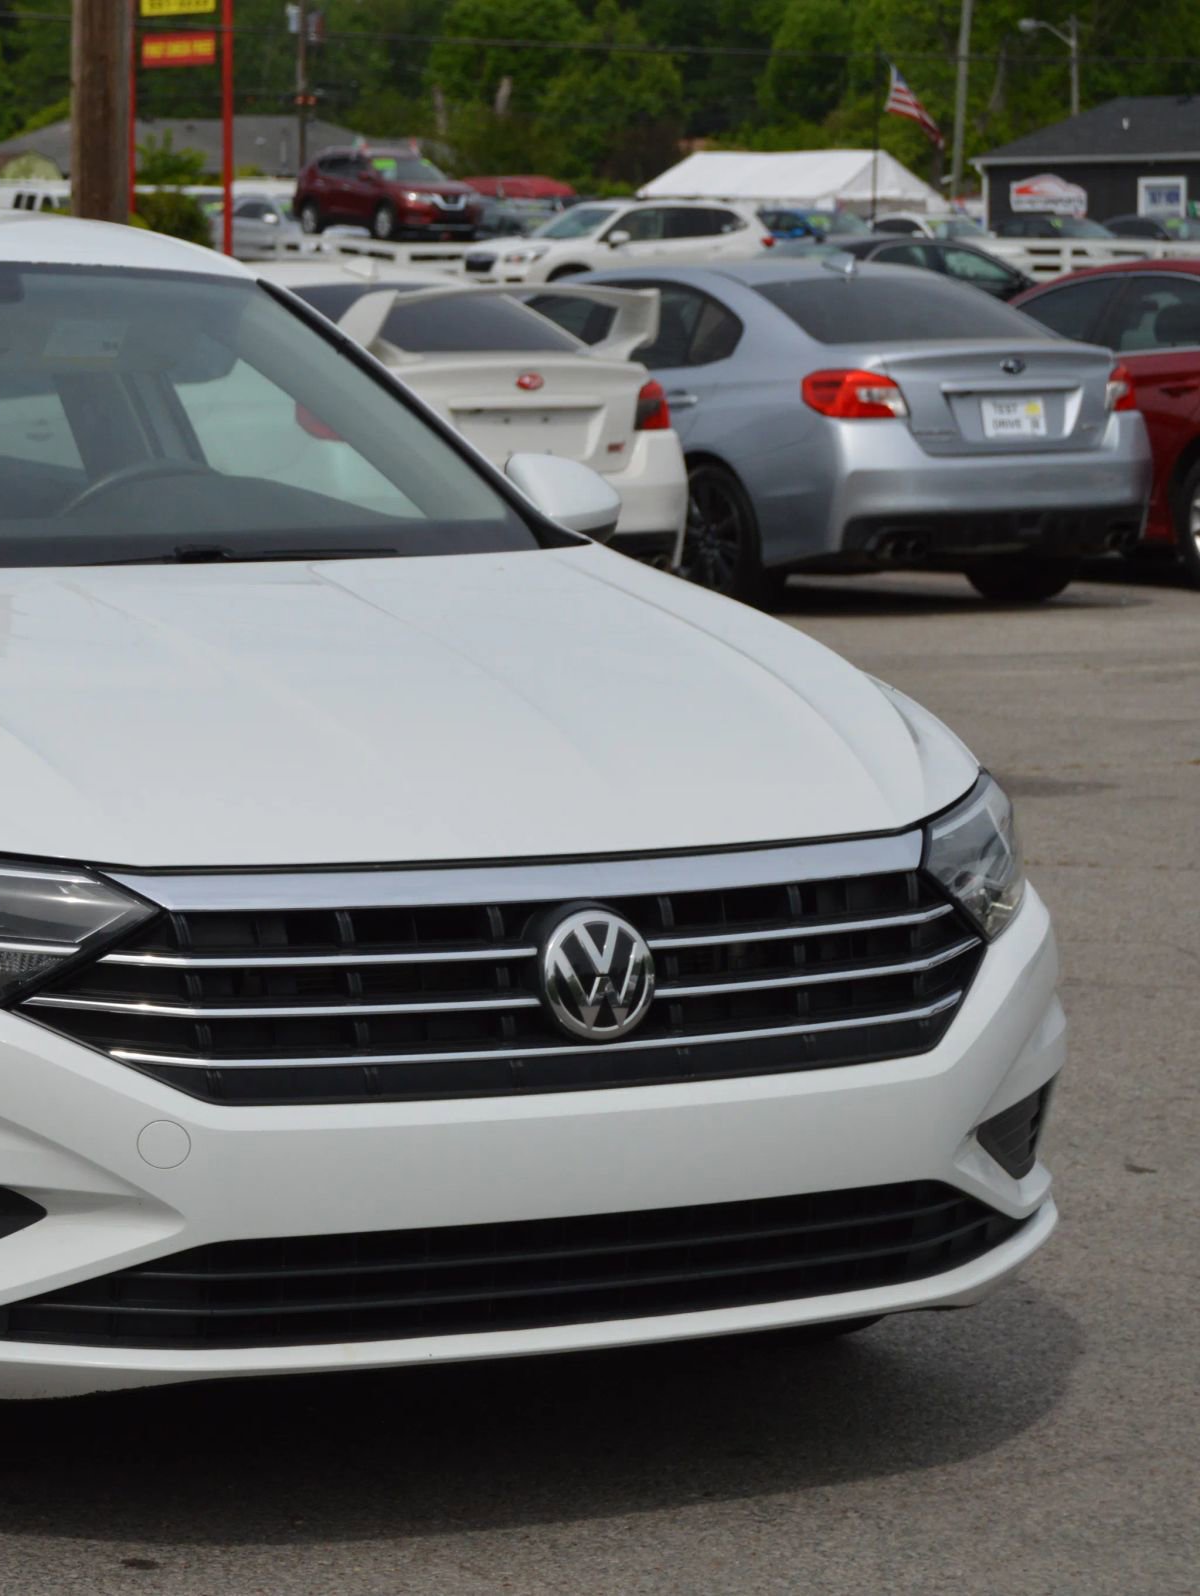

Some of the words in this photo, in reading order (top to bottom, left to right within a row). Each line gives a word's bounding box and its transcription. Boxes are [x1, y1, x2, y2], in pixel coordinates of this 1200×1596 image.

[992, 402, 1018, 415] TEST
[992, 418, 1022, 430] DRIVE
[545, 910, 655, 1040] VW
